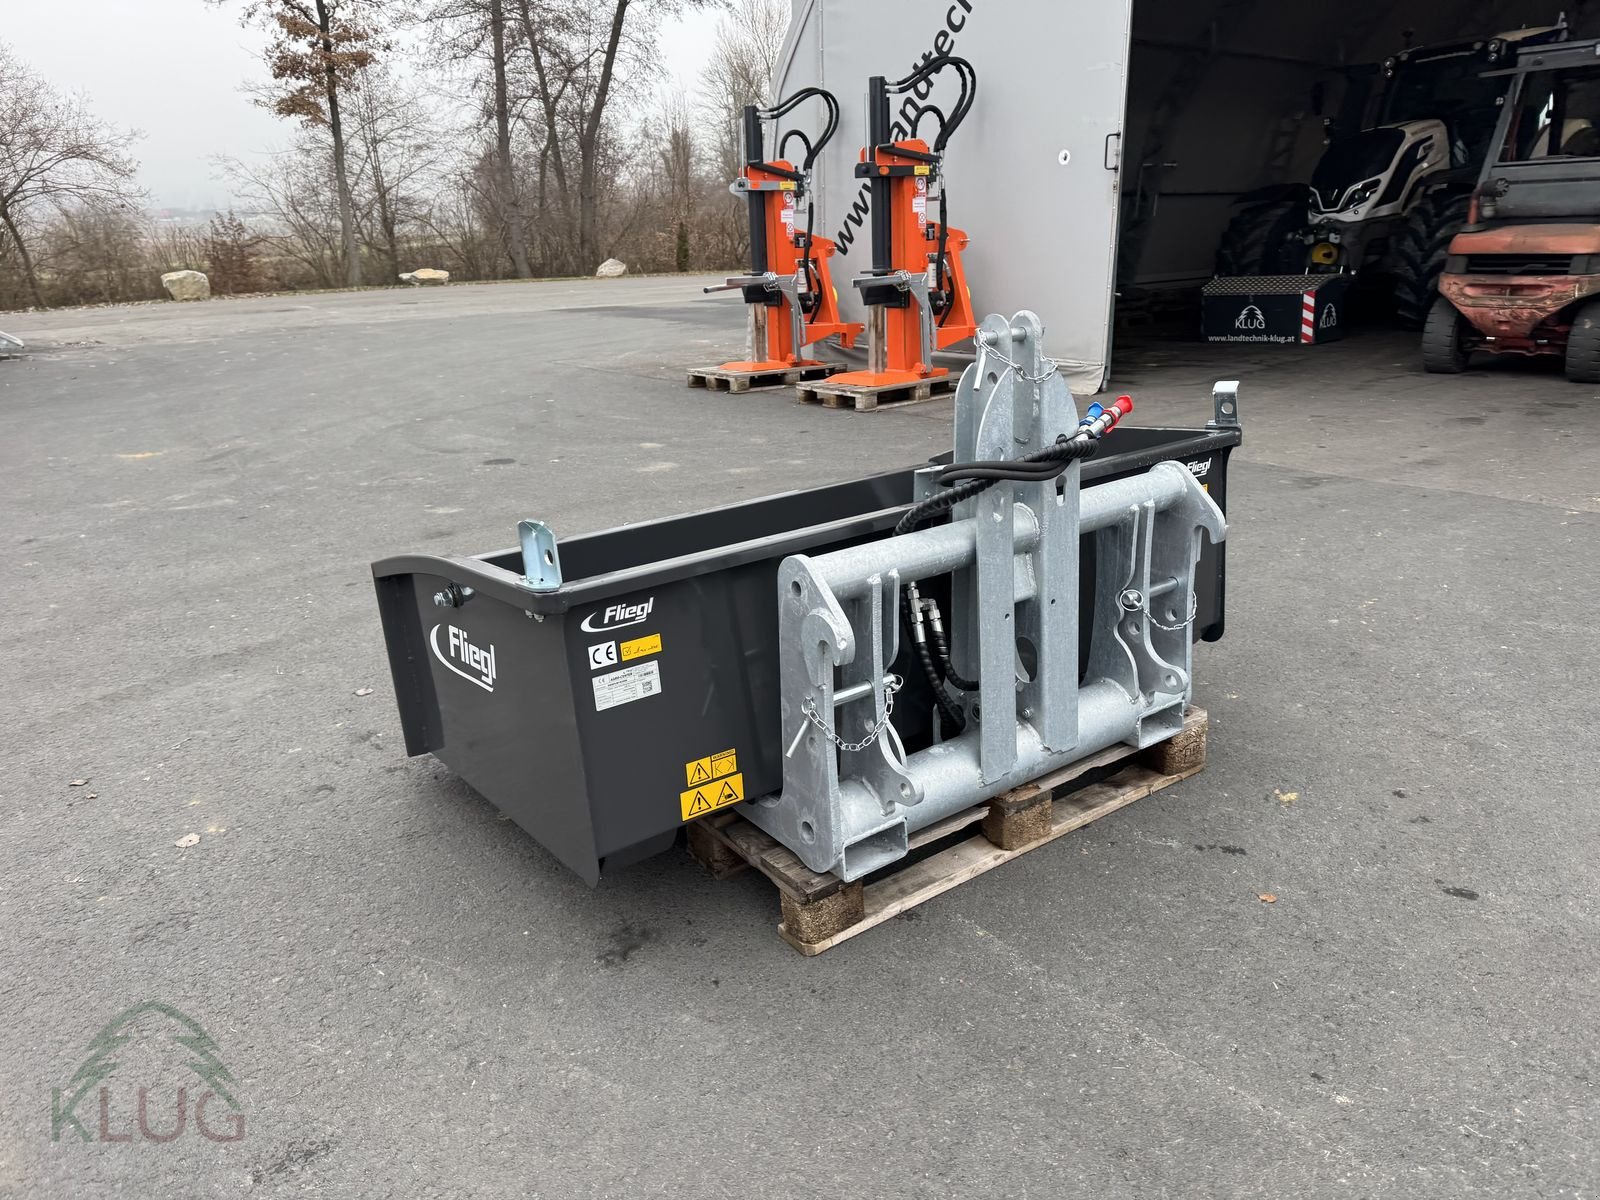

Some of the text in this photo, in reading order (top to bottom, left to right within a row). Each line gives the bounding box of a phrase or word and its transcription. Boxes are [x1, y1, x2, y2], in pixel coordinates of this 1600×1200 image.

[1235, 319, 1265, 329] KLUG
[1319, 317, 1337, 328] KLUG
[1208, 334, 1295, 344] www.landtechnik-klug.at
[1187, 457, 1211, 474] Fliegl
[604, 597, 654, 624] Fliegl
[448, 624, 496, 685] Fliegl
